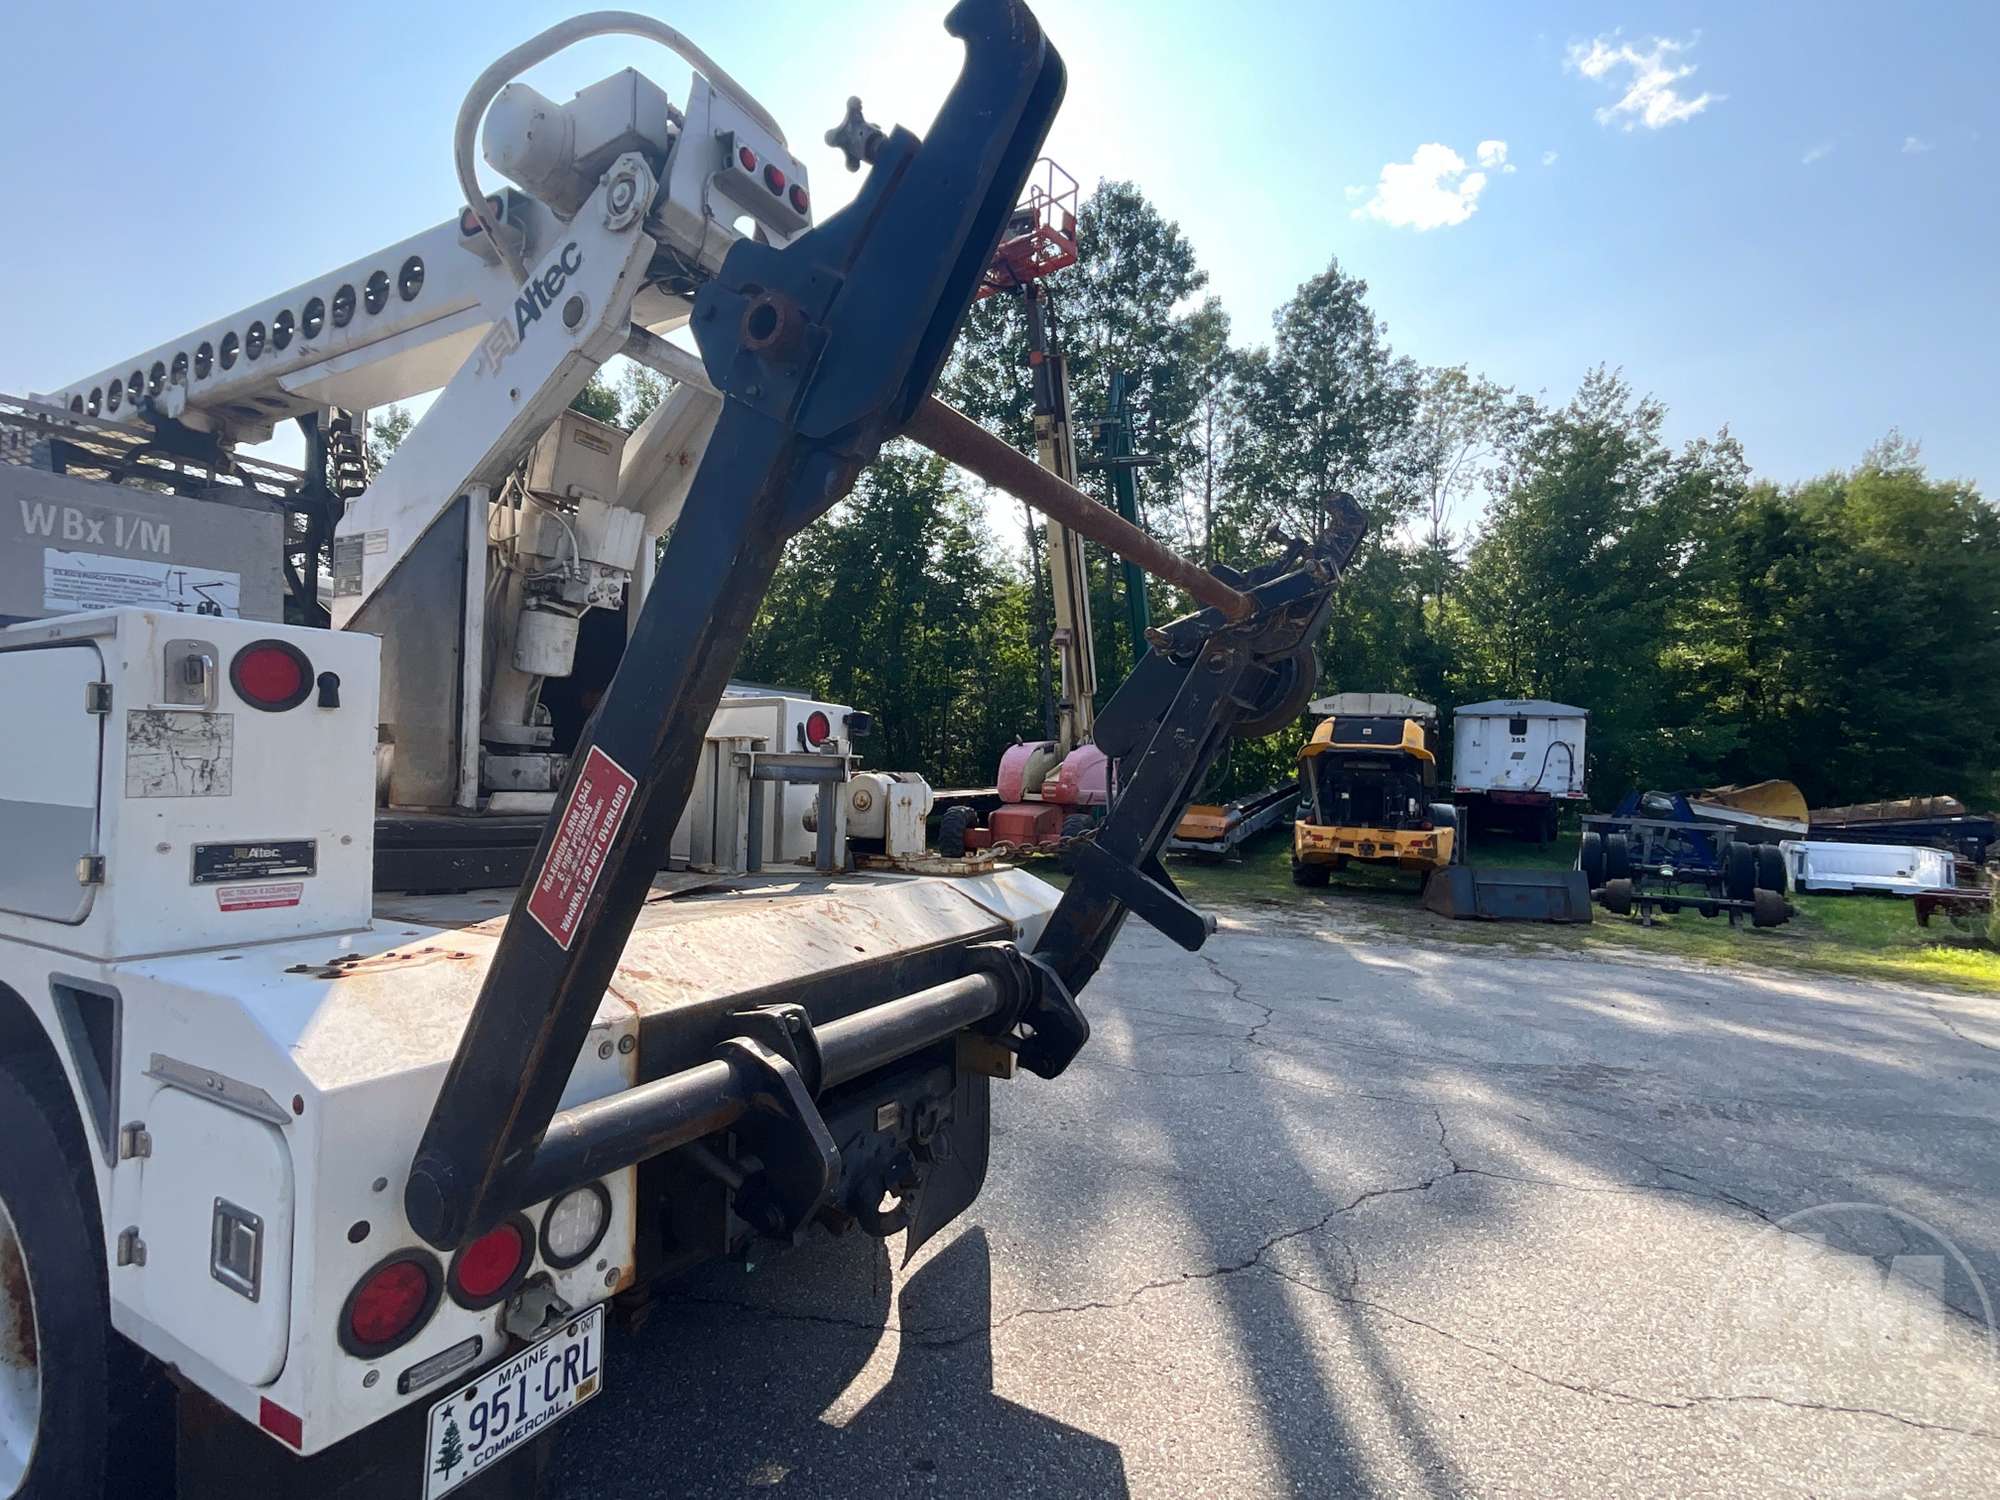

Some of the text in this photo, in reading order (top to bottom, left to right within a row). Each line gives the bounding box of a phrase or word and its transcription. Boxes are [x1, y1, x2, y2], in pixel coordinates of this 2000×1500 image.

[515, 242, 581, 343] Altec
[115, 516, 170, 554] I/M
[249, 847, 280, 858] Altec
[542, 835, 570, 893] MAXIMUM
[564, 808, 581, 838] ARM
[577, 780, 593, 811] LOAD
[560, 880, 586, 933] WARNING
[580, 864, 593, 884] DO
[587, 840, 603, 867] NOT
[598, 783, 627, 843] OVERLOAD
[498, 1344, 550, 1386] MAINE
[473, 1401, 564, 1468] COMMERCIAL
